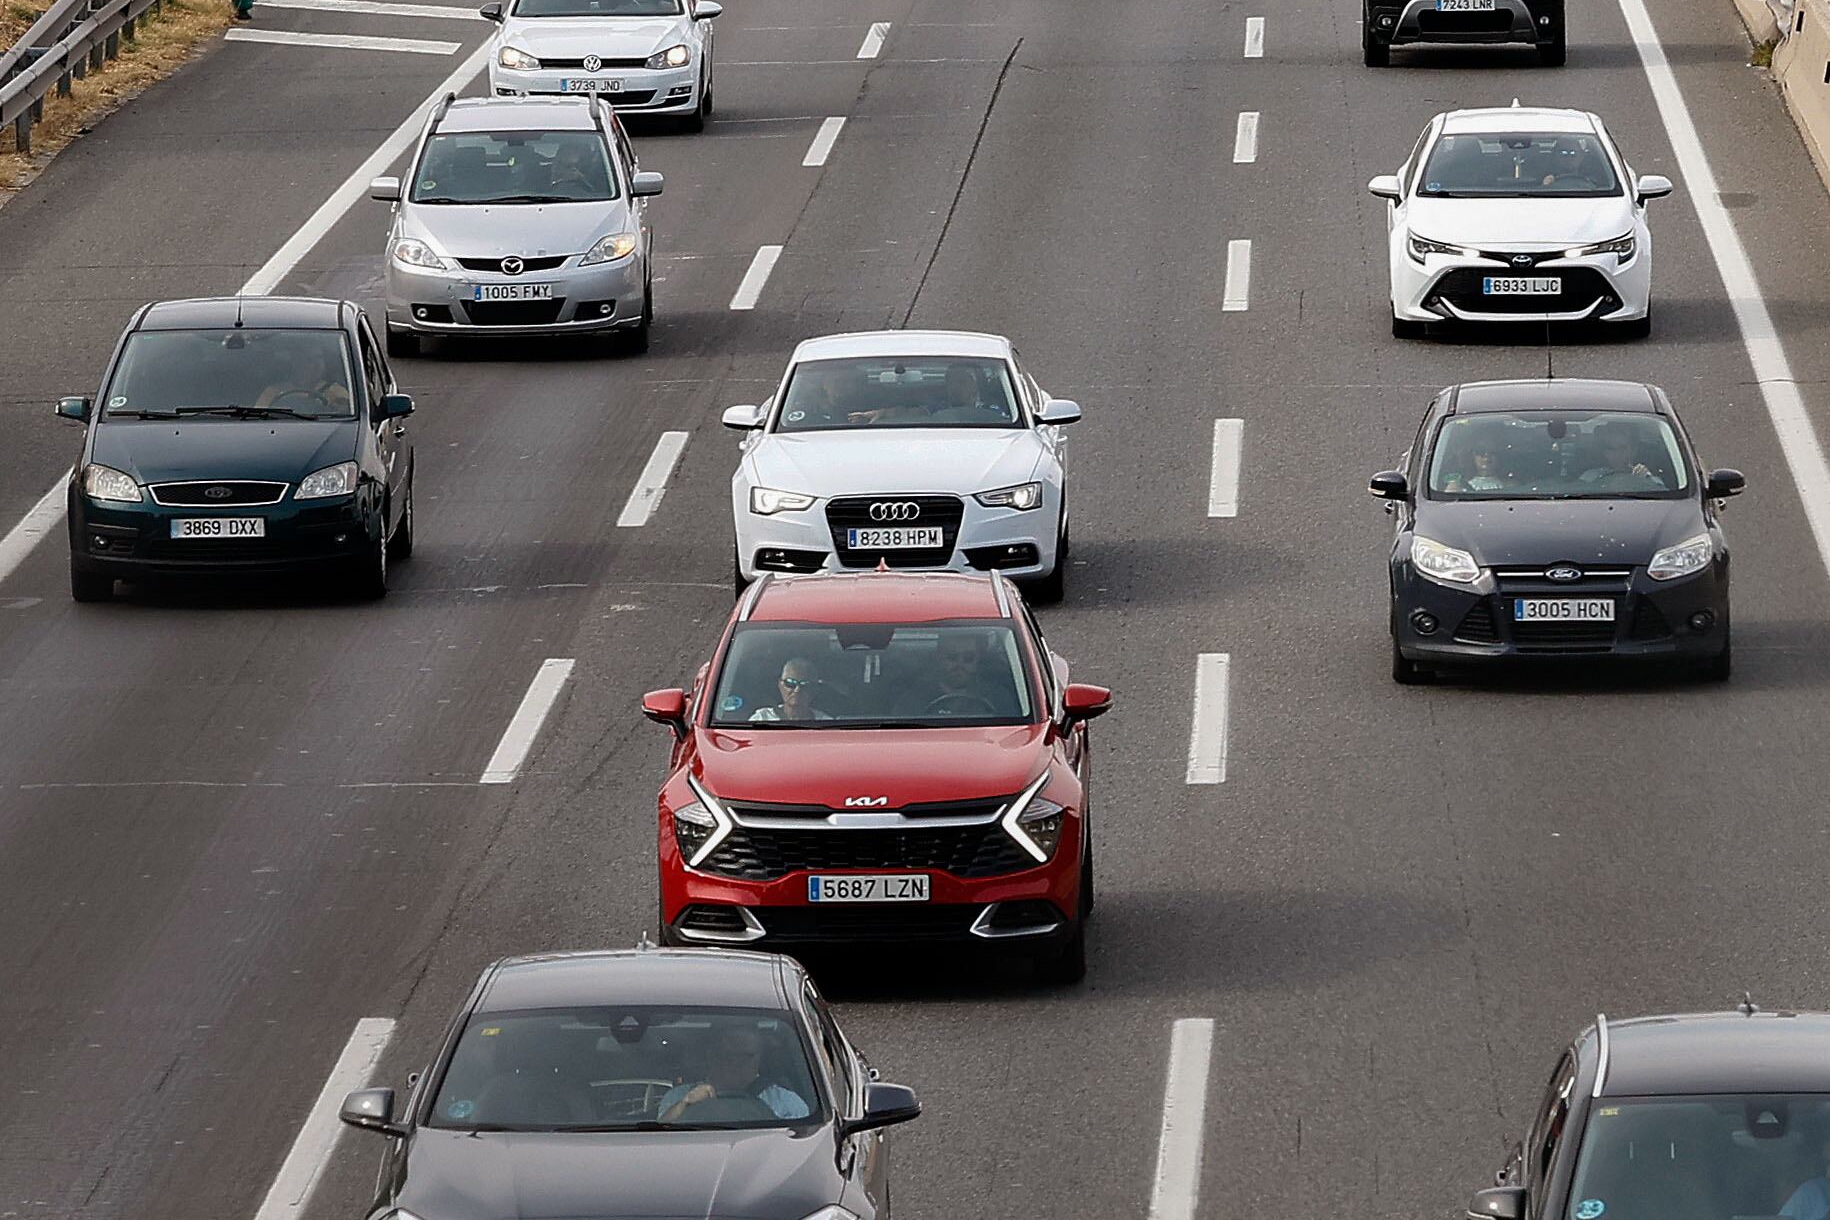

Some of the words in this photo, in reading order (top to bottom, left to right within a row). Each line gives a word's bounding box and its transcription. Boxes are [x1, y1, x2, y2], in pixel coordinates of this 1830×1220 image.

[1443, 0, 1470, 9] 7243
[1472, 0, 1493, 9] LNR
[570, 80, 596, 92] 3739
[483, 285, 518, 299] 1005
[522, 284, 550, 298] FMY
[1493, 280, 1528, 292] 6933
[1532, 280, 1559, 291] LJC
[183, 520, 221, 536] 3869
[229, 519, 258, 535] DXX
[860, 531, 902, 546] 8238
[907, 530, 938, 545] HPM
[1527, 601, 1571, 618] 3005
[1577, 601, 1611, 618] HCN
[823, 879, 877, 899] 5687
[883, 878, 924, 898] LZN
